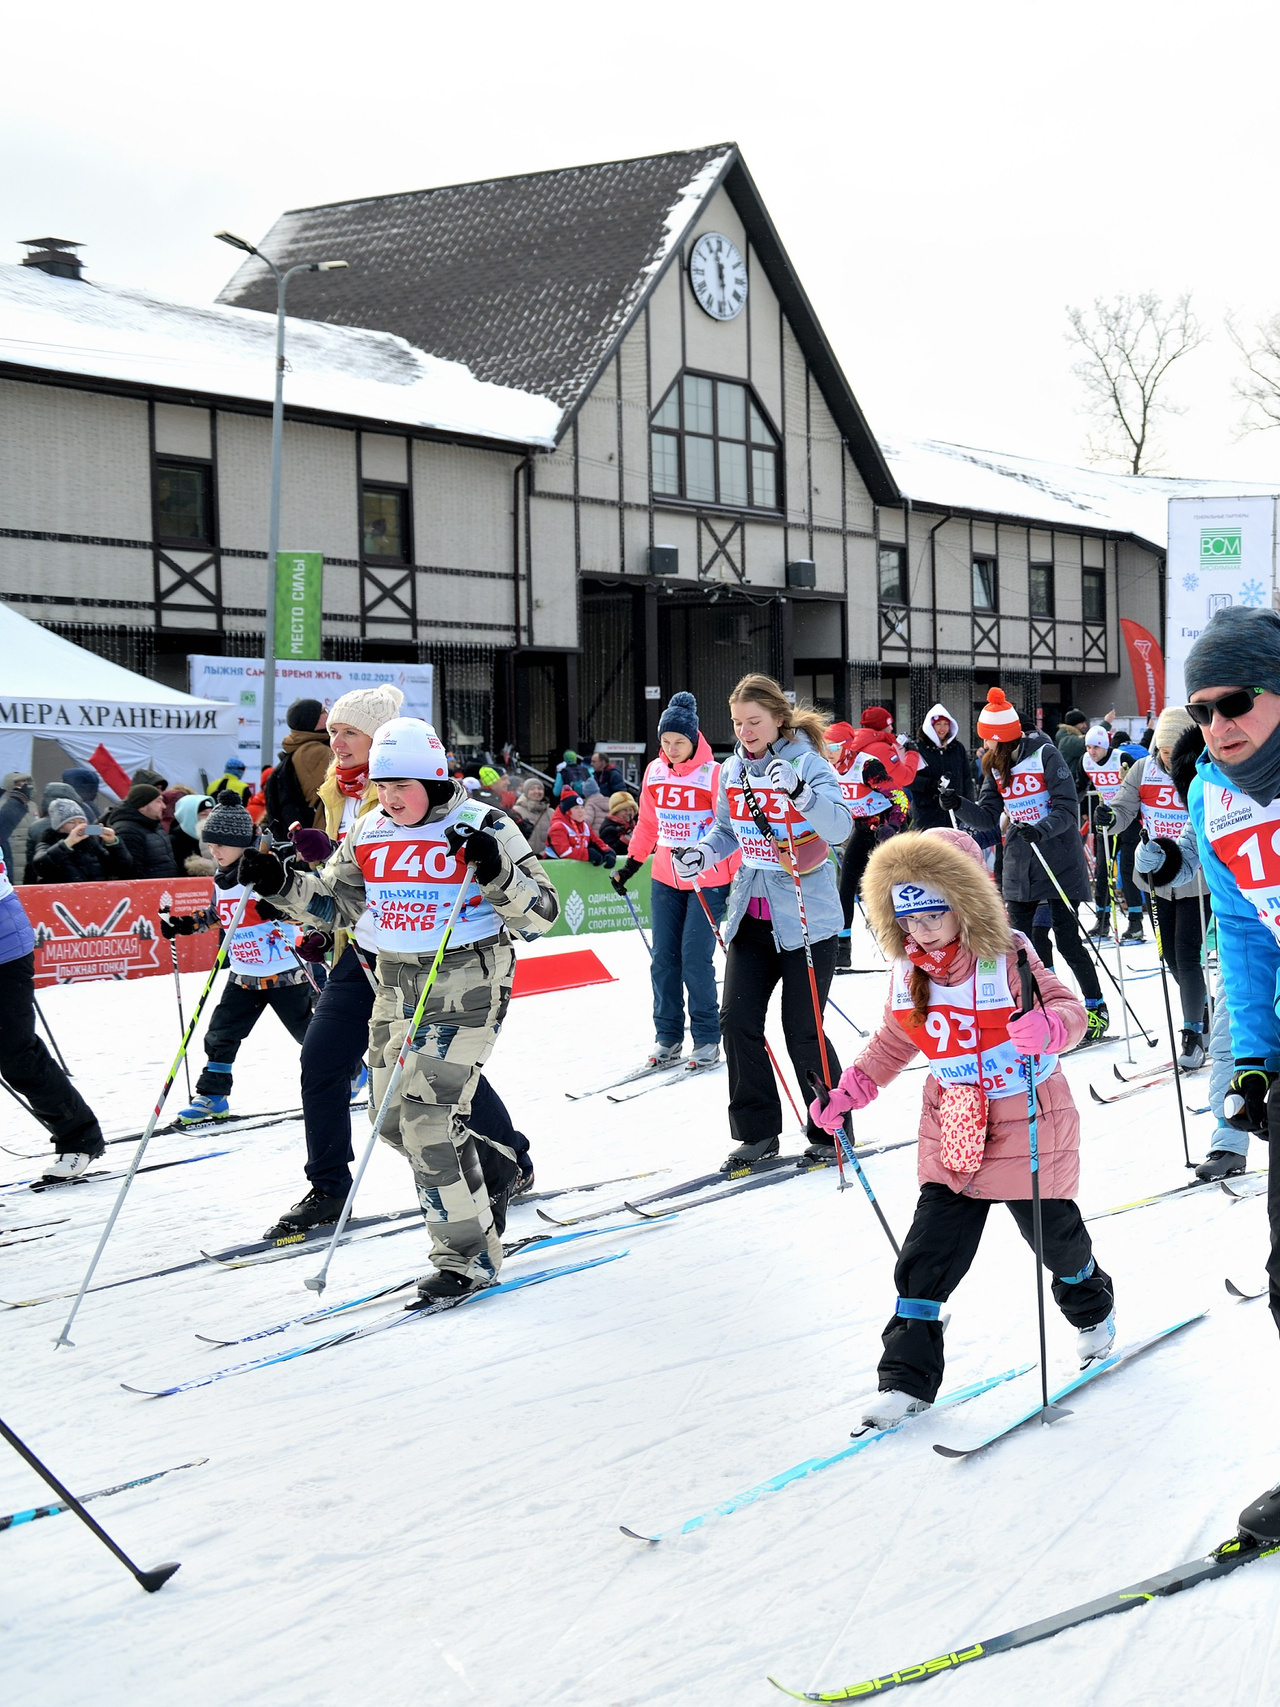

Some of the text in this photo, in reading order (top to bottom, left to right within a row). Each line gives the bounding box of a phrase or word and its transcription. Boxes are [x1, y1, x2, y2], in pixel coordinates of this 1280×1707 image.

[290, 558, 306, 655] МЕСТО СИЛЫ
[203, 665, 244, 677] ЛЫЖНЯ
[246, 667, 280, 678] САМЕ
[281, 669, 312, 679] ВРЕМЯ
[315, 670, 342, 681] ЖИТЬ
[349, 672, 395, 683] 18.02.2023
[79, 704, 218, 730] ХРАНЕНИЯ
[1089, 772, 1119, 785] 788
[654, 785, 696, 809] 151
[733, 791, 786, 820] 123
[1008, 798, 1037, 810] ЛЫЖНЯ
[659, 812, 691, 821] ЛЫЖНЯ
[1010, 807, 1039, 817] САМОЕ
[1153, 811, 1189, 821] ЛЫЖНЯ
[1227, 805, 1252, 821] БОРЬБЫ
[660, 822, 691, 831] САМОЕ
[1154, 826, 1182, 835] ВРЕМ
[741, 836, 772, 848] САМО
[369, 844, 457, 879] 140
[378, 889, 439, 901] ЛЫЖНЯ
[380, 900, 438, 913] САМОЕ
[912, 899, 945, 907] ЖИЗНИ
[587, 906, 607, 917] ПАРК
[380, 919, 435, 932] ЖИТЬ
[587, 918, 615, 930] СПОРТА
[615, 917, 621, 928] И
[45, 937, 139, 961] МАНЖОСОВСКАЯ
[231, 940, 258, 950] АМОЕ
[233, 949, 262, 959] РЕМЯ
[60, 961, 125, 978] ЛЫЖНАЯ ГОНКА
[925, 1012, 975, 1053] 93
[730, 1167, 752, 1180] DYNAMIC
[276, 1232, 306, 1248] DYNAMIC
[819, 1643, 984, 1701] FISCHER
